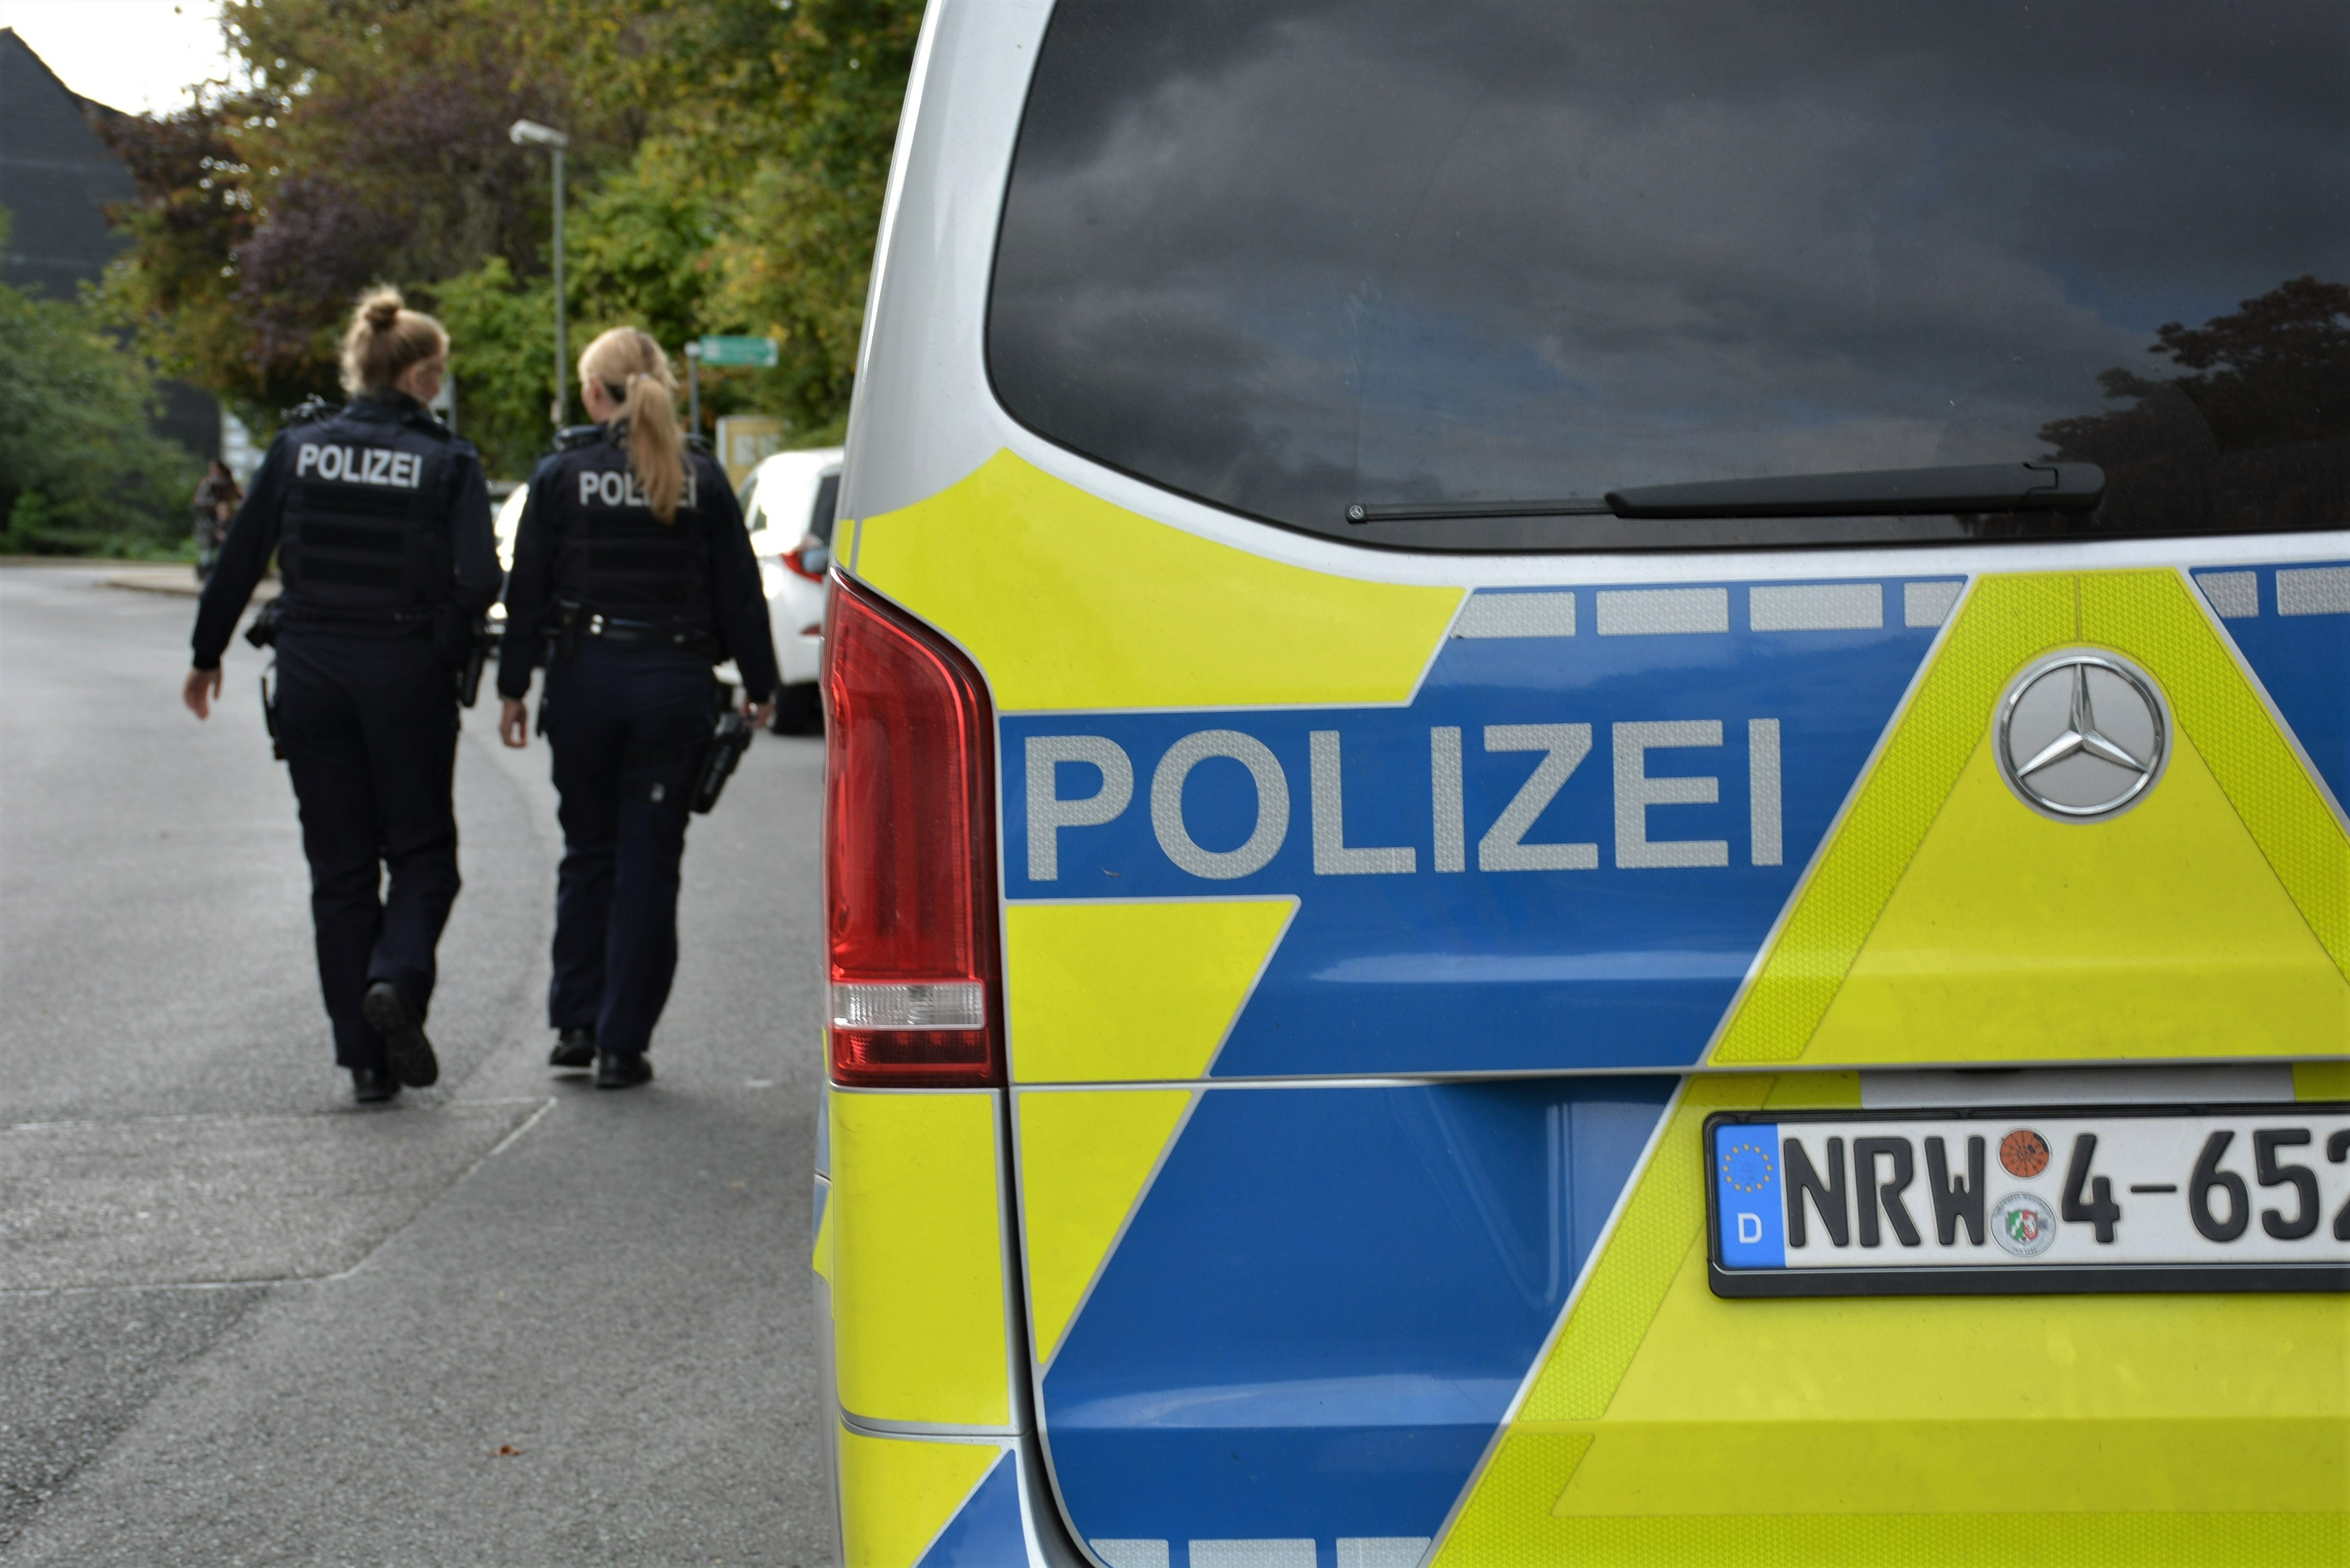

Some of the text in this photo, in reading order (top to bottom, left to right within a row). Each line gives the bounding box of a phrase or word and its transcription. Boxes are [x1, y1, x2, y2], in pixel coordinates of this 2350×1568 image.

[296, 442, 422, 488] POLIZEI
[579, 471, 697, 508] POLI
[1025, 718, 1783, 881] POLIZEI
[1782, 1134, 1986, 1249] NRW
[1738, 1213, 1763, 1244] D
